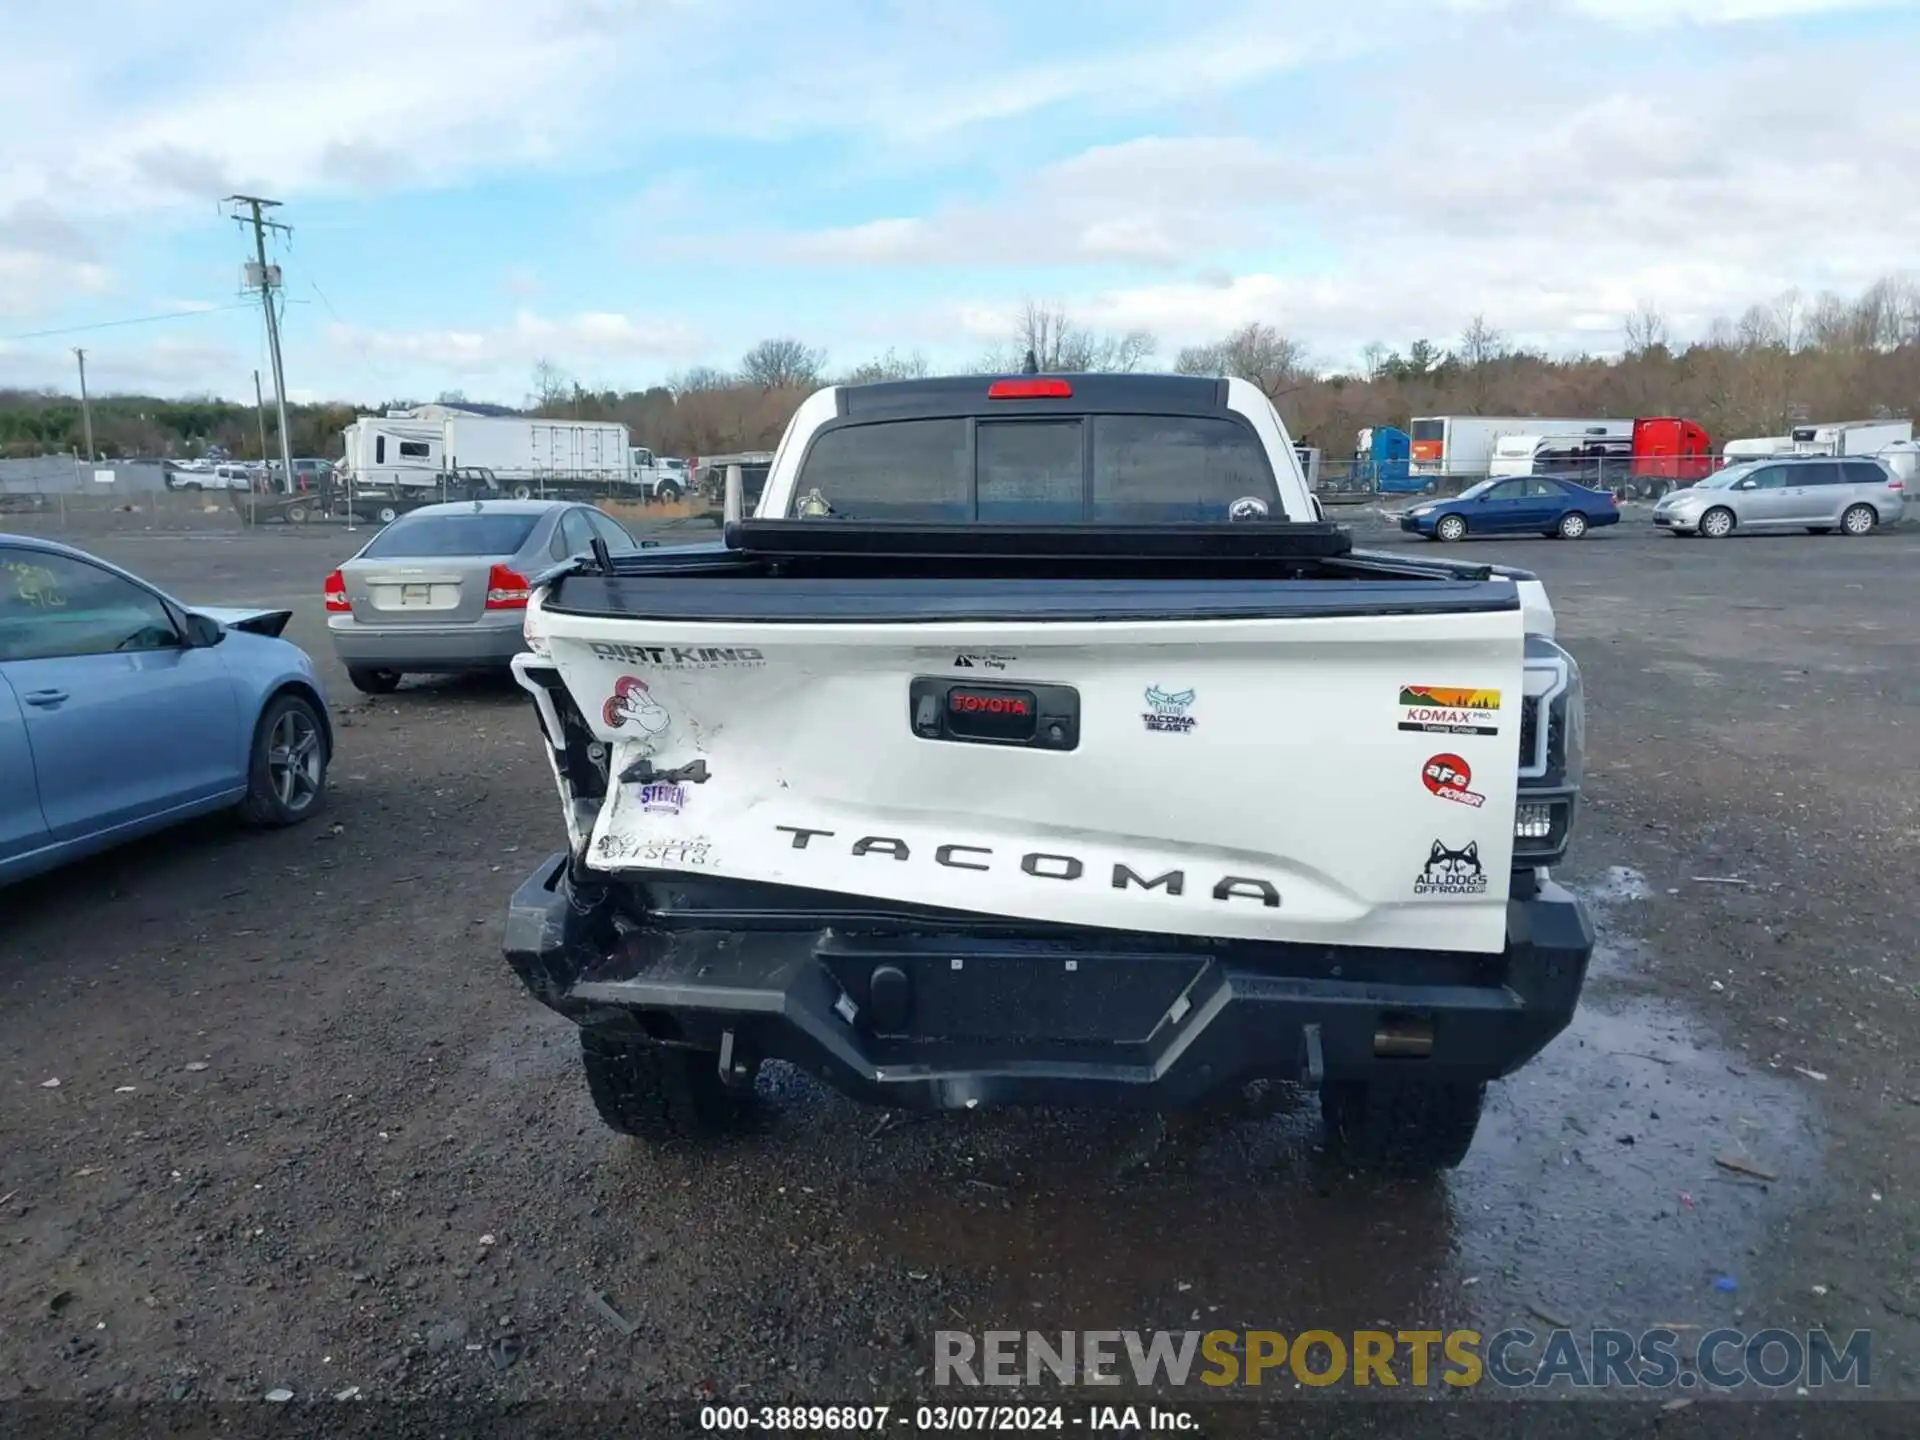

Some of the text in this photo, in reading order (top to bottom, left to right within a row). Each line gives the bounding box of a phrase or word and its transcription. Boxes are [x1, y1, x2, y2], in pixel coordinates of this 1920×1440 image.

[588, 642, 764, 664] DIRT KING
[953, 694, 1029, 715] TOYOTA
[1142, 713, 1196, 726] TACOMA
[1406, 708, 1492, 723] KDMAX PRO
[1146, 722, 1191, 733] BEAST
[1426, 764, 1467, 786] aFe
[641, 785, 685, 808] STEVEN
[1437, 786, 1483, 806] POWER
[775, 825, 1281, 908] TACOMA
[1415, 874, 1488, 885] ALLDOGS
